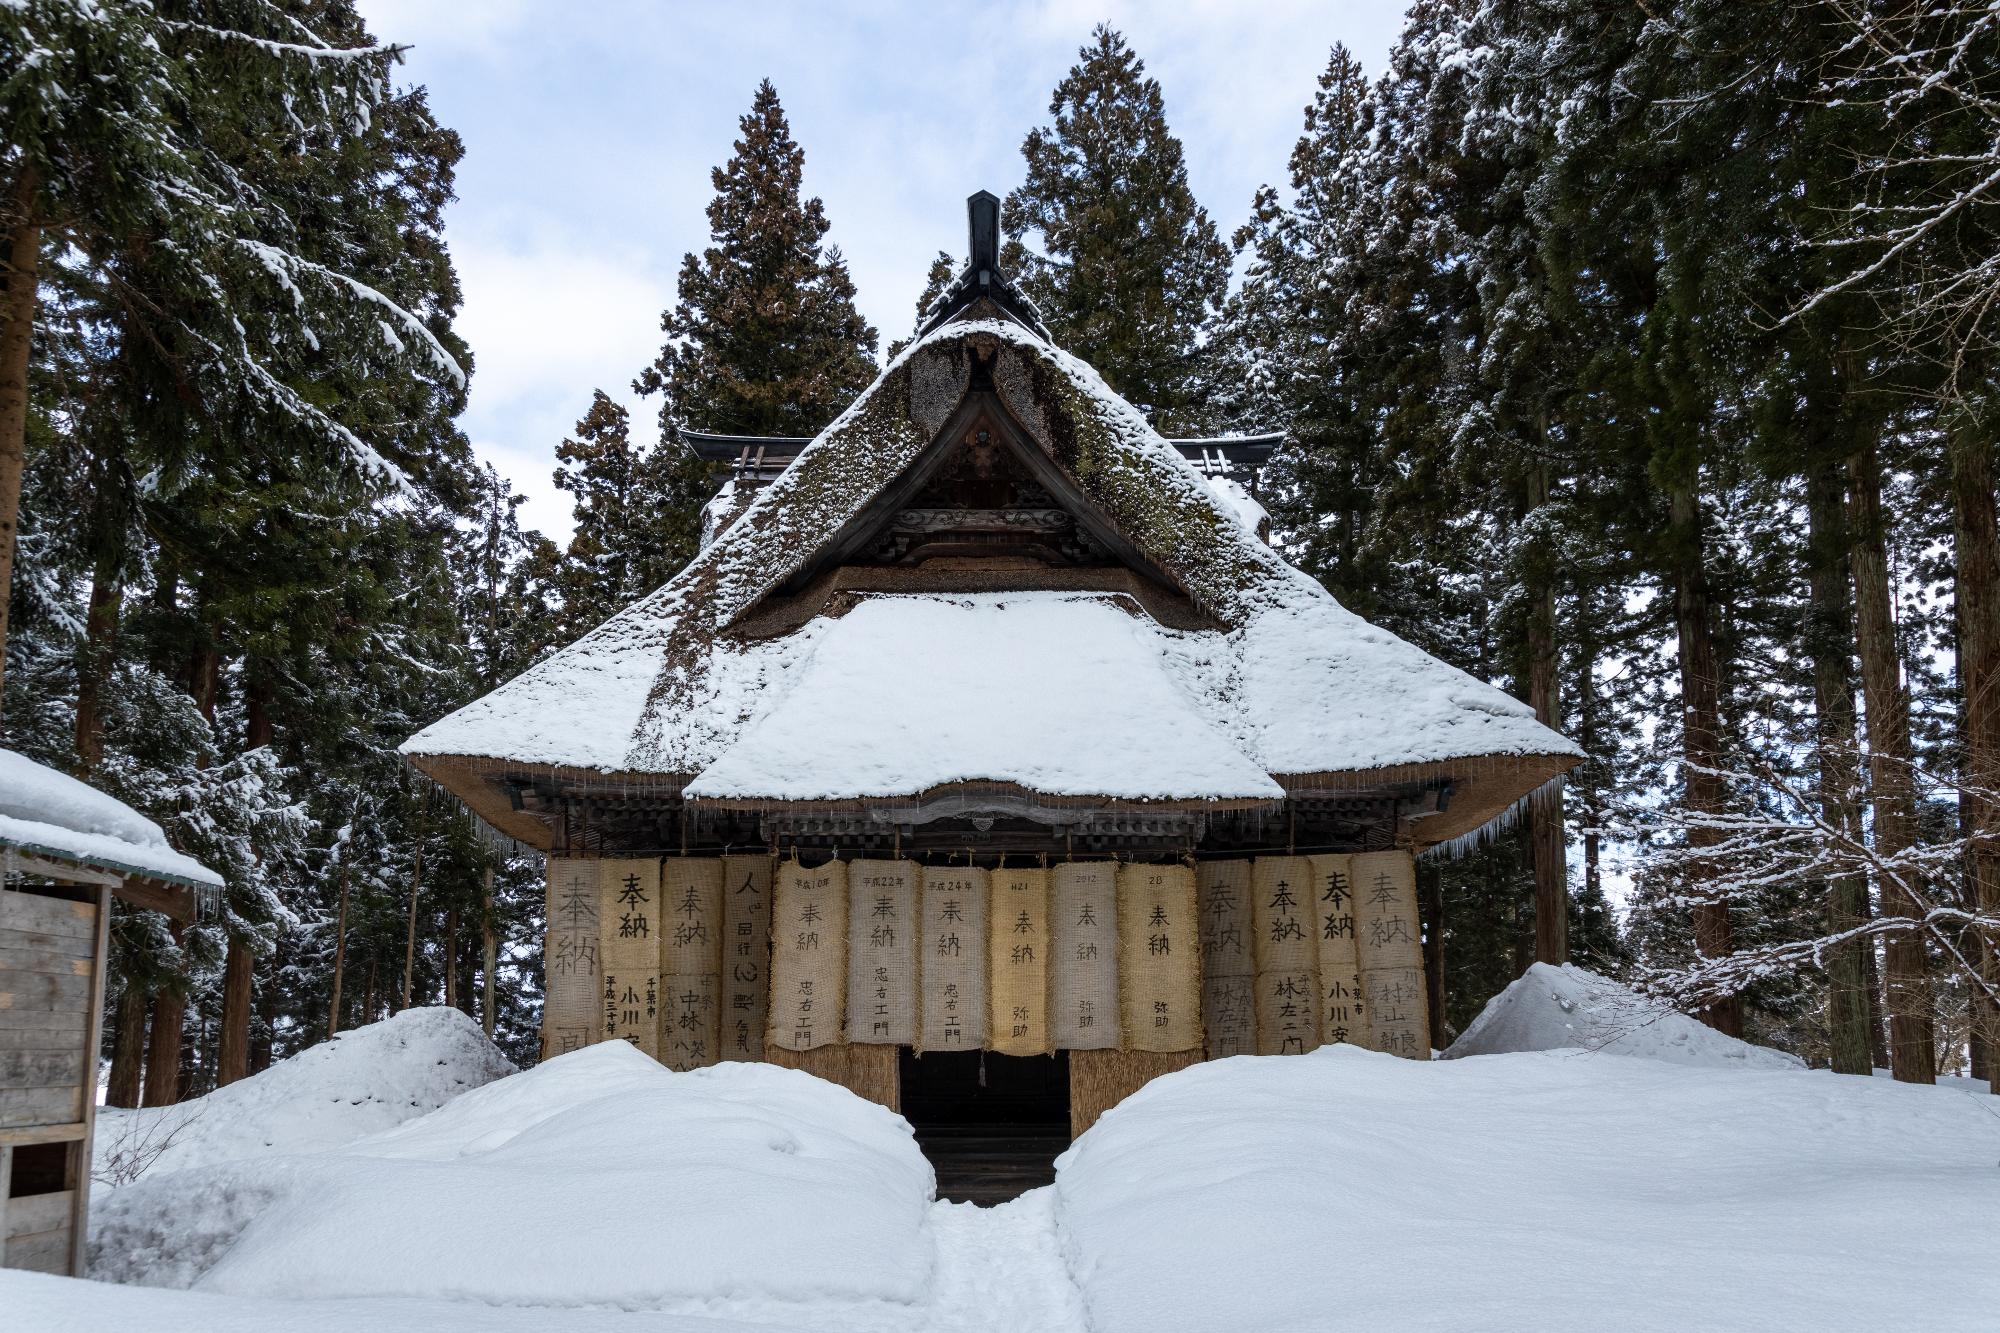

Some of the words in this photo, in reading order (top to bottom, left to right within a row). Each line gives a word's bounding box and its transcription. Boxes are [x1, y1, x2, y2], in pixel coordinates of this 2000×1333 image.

[555, 877, 599, 976] 奉納
[617, 873, 650, 939] 奉納
[673, 885, 706, 949] 奉納
[796, 903, 822, 950] 奉納
[870, 895, 896, 948] 奉納
[938, 900, 964, 958] 奉納
[1076, 903, 1097, 961] 奉納
[1148, 905, 1171, 956] 奉納
[1205, 880, 1243, 955] 奉納
[1269, 880, 1307, 943] 奉納
[1321, 872, 1354, 940] 奉納
[1366, 872, 1415, 949] 奉納
[1011, 910, 1036, 965] 奉納
[604, 975, 618, 1035] 平成三十年
[647, 977, 656, 1018] 千葉市
[1012, 1006, 1029, 1038] 弥助
[1079, 1000, 1094, 1028] 弥助
[1154, 1001, 1169, 1028] 弥助
